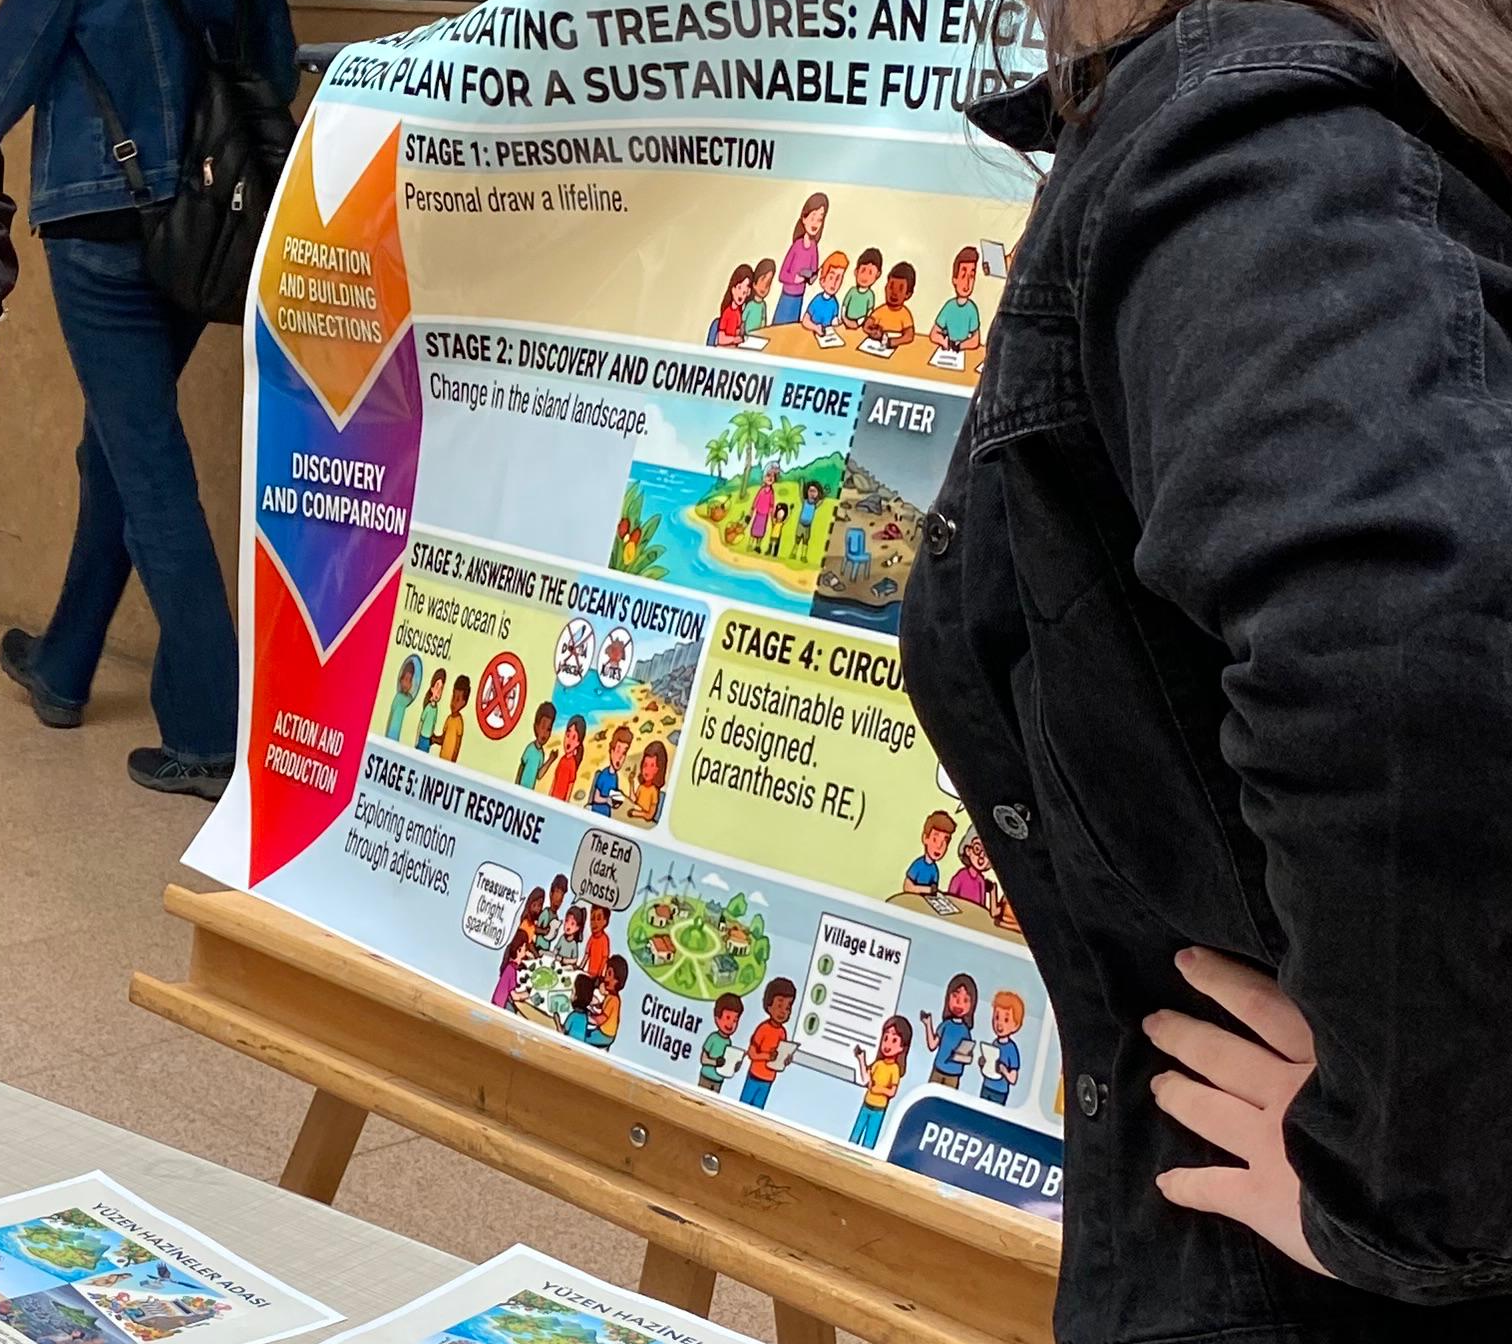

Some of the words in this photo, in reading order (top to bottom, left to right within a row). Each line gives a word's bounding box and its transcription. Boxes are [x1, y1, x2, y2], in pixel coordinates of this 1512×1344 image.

[439, 6, 579, 51] FLOATING
[329, 54, 397, 91] LESSON
[389, 57, 454, 102] PLAN
[461, 63, 533, 107] FOR
[544, 69, 576, 106] A
[583, 59, 869, 106] SUSTAINABLE
[405, 133, 466, 166] STAGE
[470, 142, 491, 167] 1:
[495, 137, 623, 167] PERSONAL
[628, 135, 775, 170] CONNECTION
[404, 182, 483, 214] Personal
[489, 182, 536, 212] draw
[542, 191, 555, 212] a
[558, 182, 628, 214] lifeline.
[283, 236, 371, 276] PREPARATION
[278, 272, 305, 300] AND
[308, 278, 377, 310] BUILDING
[277, 306, 382, 344] CONNECTIONS
[425, 332, 491, 362] STAGE
[497, 337, 514, 365] 2:
[518, 340, 608, 380] DISCOVERY
[608, 352, 648, 386] AND
[652, 359, 774, 406] COMPARISON
[430, 372, 487, 409] Change
[491, 379, 504, 409] in
[508, 383, 529, 413] the
[531, 387, 568, 421] island
[572, 393, 649, 439] landscape.
[781, 382, 852, 417] BEFORE
[868, 397, 935, 433] AFTER
[292, 452, 385, 492] DISCOVERY
[261, 485, 298, 514] AND
[302, 489, 407, 536] COMPARISON
[404, 583, 425, 613] The
[427, 595, 460, 627] waste
[460, 605, 495, 634] ocean
[499, 610, 511, 640] is
[410, 542, 453, 576] STAGE
[450, 553, 464, 583] 3:
[465, 557, 536, 600] ANSWERING
[540, 574, 567, 606] THE
[568, 582, 630, 624] OCEAN'S
[631, 597, 705, 642] QUESTION
[395, 619, 452, 662] discussed.
[720, 621, 795, 666] STAGE
[798, 639, 823, 673] 4:
[828, 646, 909, 694] CIRCU
[273, 710, 318, 749] ACTION
[319, 725, 344, 757] AND
[708, 668, 724, 701] A
[726, 678, 844, 731] sustainable
[851, 706, 916, 754] village
[700, 707, 716, 741] is
[720, 717, 817, 768] designed.
[264, 745, 338, 795] PRODUCTION
[690, 748, 815, 812] (paranthesis
[821, 781, 867, 829] RE.)
[364, 753, 407, 793] STAGE
[402, 768, 417, 799] 5:
[418, 775, 465, 815] INPUT
[464, 790, 546, 845] RESPONSE
[354, 792, 405, 839] Exploring
[405, 816, 456, 858] emotion
[344, 828, 390, 871] through
[389, 847, 450, 897] adjectives.
[590, 834, 608, 857] The
[610, 840, 631, 864] End
[579, 876, 620, 906] ghosts)
[464, 913, 506, 947] sparkling)
[823, 923, 866, 955] Village
[867, 938, 901, 965] Laws
[641, 993, 703, 1034] Circular
[640, 1021, 693, 1060] Village
[919, 1122, 1041, 1190] PREPARED
[1041, 1167, 1063, 1201] B
[92, 1202, 143, 1232] YÜZEN
[138, 1231, 221, 1280] HAZİNELER
[217, 1281, 271, 1308] ADASI
[543, 1281, 612, 1313] YÜZEN
